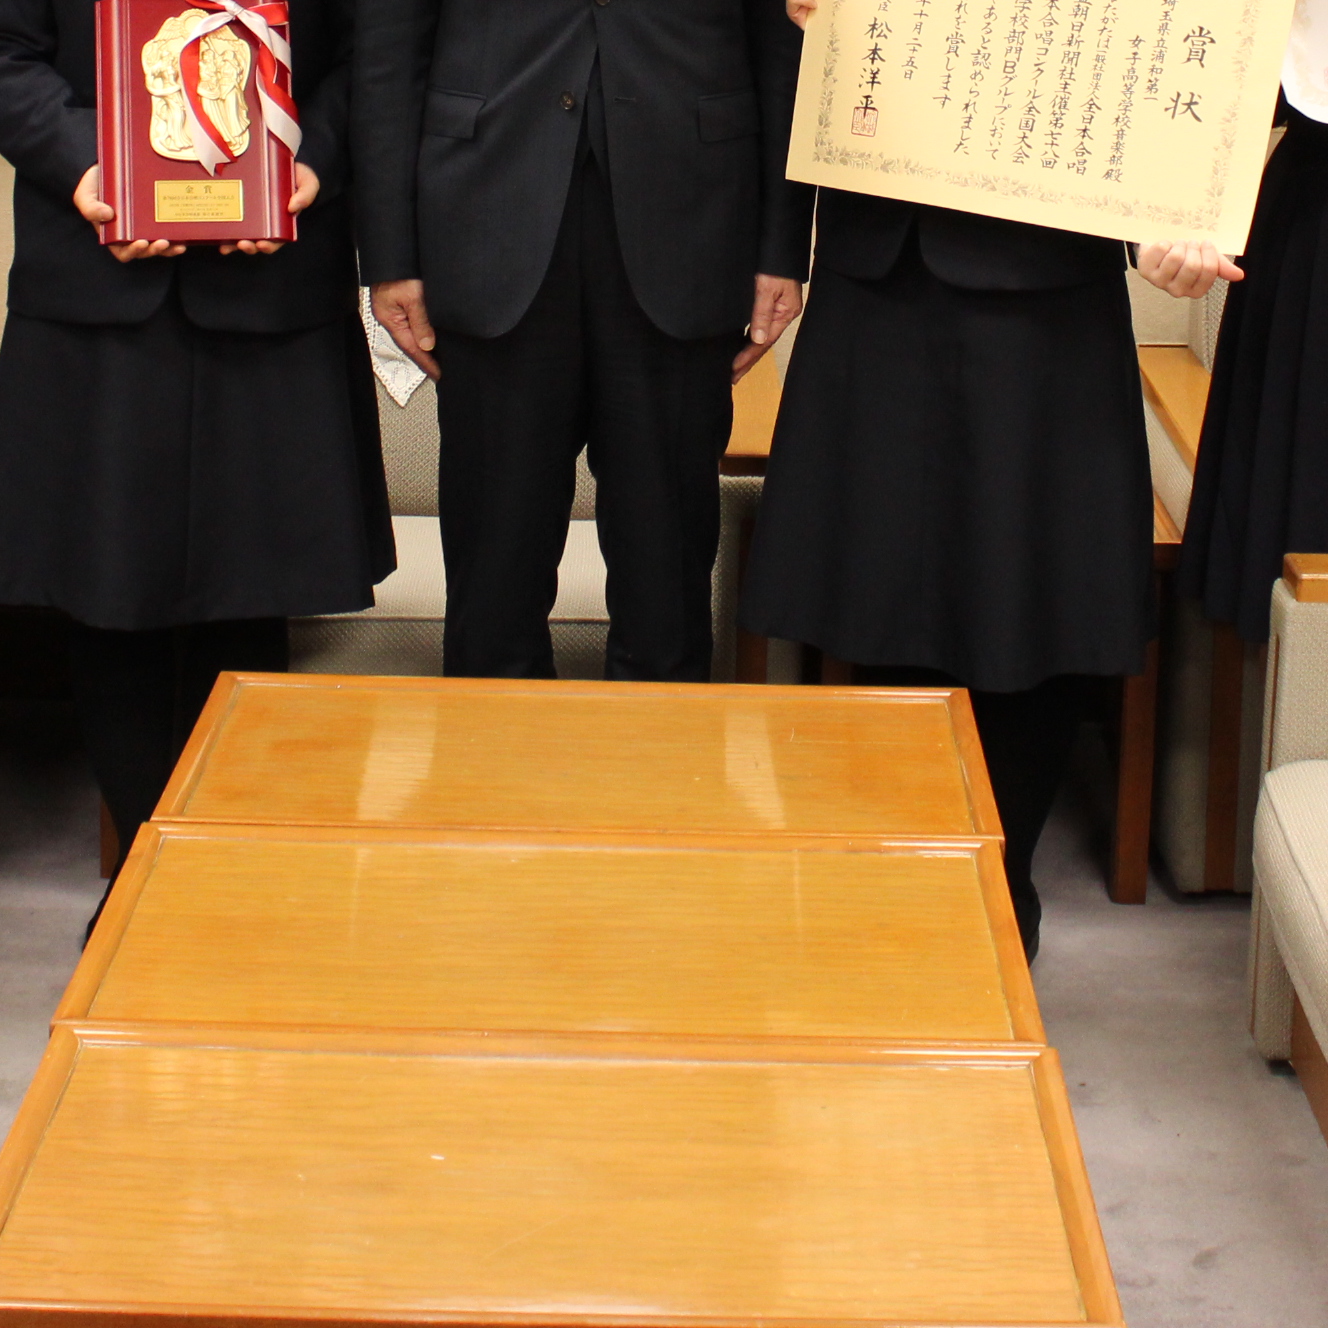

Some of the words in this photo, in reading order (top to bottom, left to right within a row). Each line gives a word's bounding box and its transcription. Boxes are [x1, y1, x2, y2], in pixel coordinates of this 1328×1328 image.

[858, 16, 893, 118] 松本洋平
[1102, 35, 1146, 183] 女子高等学校音楽部殿
[1164, 25, 1217, 123] 賞状
[186, 185, 212, 194] 金賞
